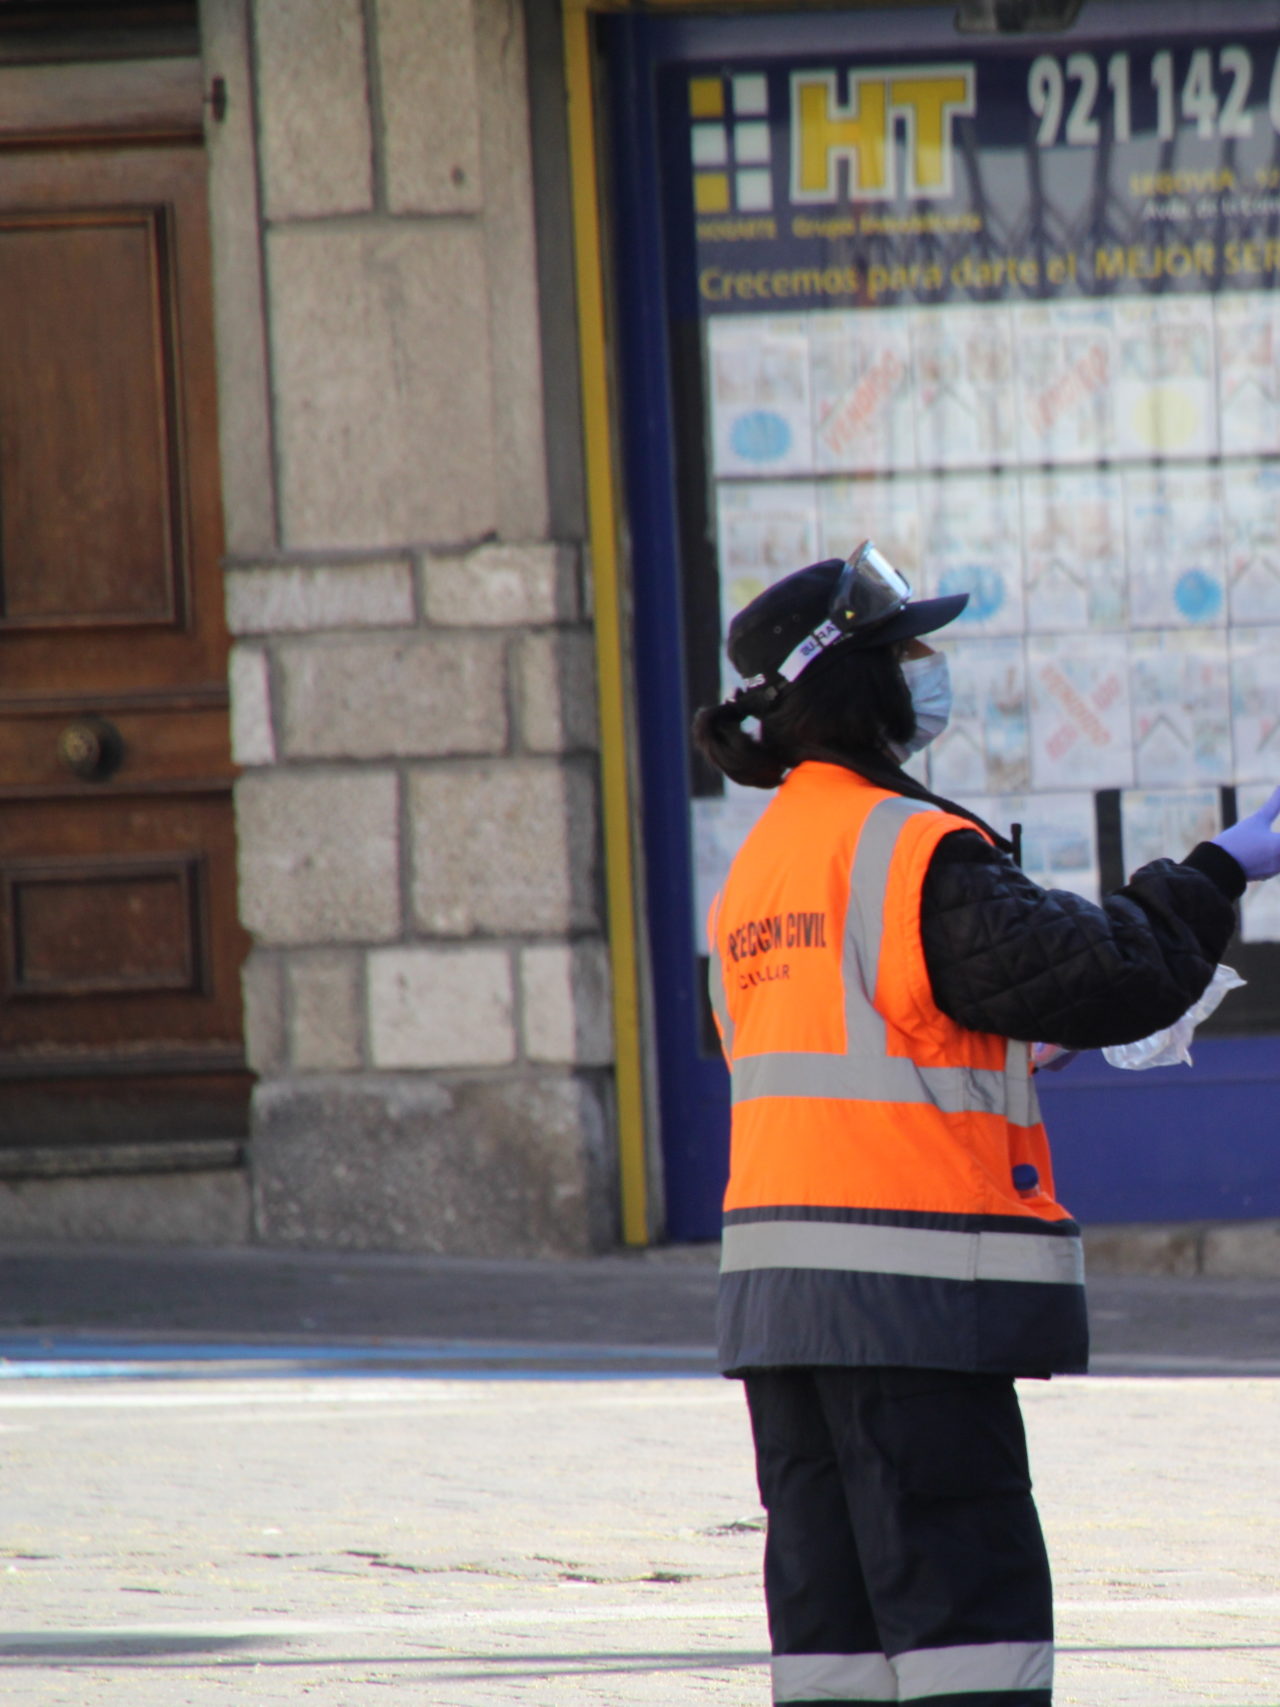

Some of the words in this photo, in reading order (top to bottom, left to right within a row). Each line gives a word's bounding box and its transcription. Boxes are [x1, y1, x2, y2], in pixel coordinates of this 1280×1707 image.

[790, 62, 976, 203] HT
[1029, 54, 1130, 146] 921
[1150, 46, 1251, 142] 142
[700, 267, 857, 300] Crecemos
[867, 263, 942, 299] para
[952, 255, 1038, 288] darte
[1047, 252, 1077, 285] el
[1095, 242, 1215, 281] MEJOR
[786, 912, 826, 948] CIVIL
